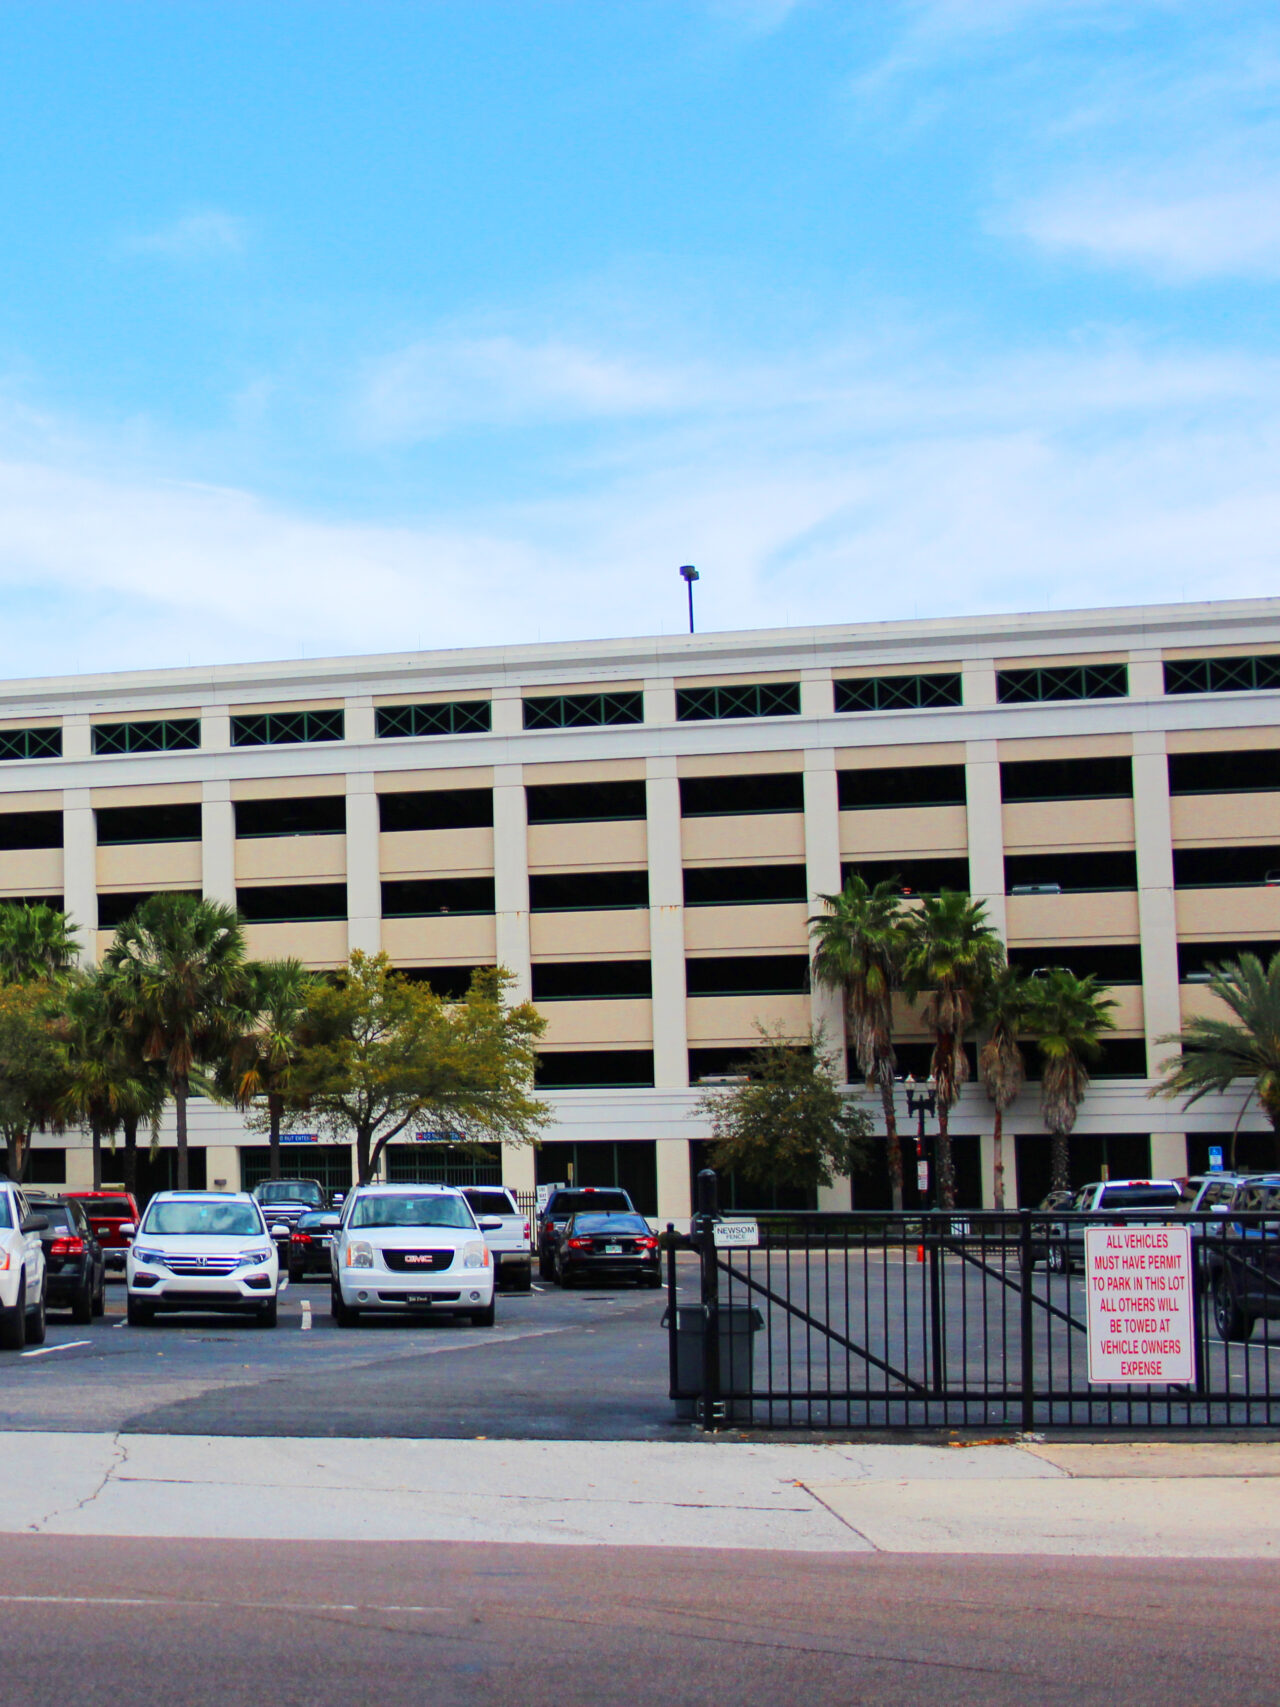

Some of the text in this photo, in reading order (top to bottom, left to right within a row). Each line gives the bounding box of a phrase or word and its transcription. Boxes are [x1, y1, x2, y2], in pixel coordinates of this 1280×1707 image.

[717, 1226, 755, 1234] NEWSOM
[1106, 1234, 1168, 1249] ALL VEHICLES
[404, 1255, 433, 1264] GMC
[1094, 1255, 1182, 1270] MUST HAVE PERMIT
[1092, 1276, 1185, 1291] TO PARK IN THIS LOT
[1100, 1298, 1179, 1312] ALL OTHERS WILL
[1110, 1319, 1170, 1333] BE TOWED AT
[1100, 1340, 1181, 1354] VEHICLE OWNERS
[1121, 1361, 1162, 1375] EXPENSE
